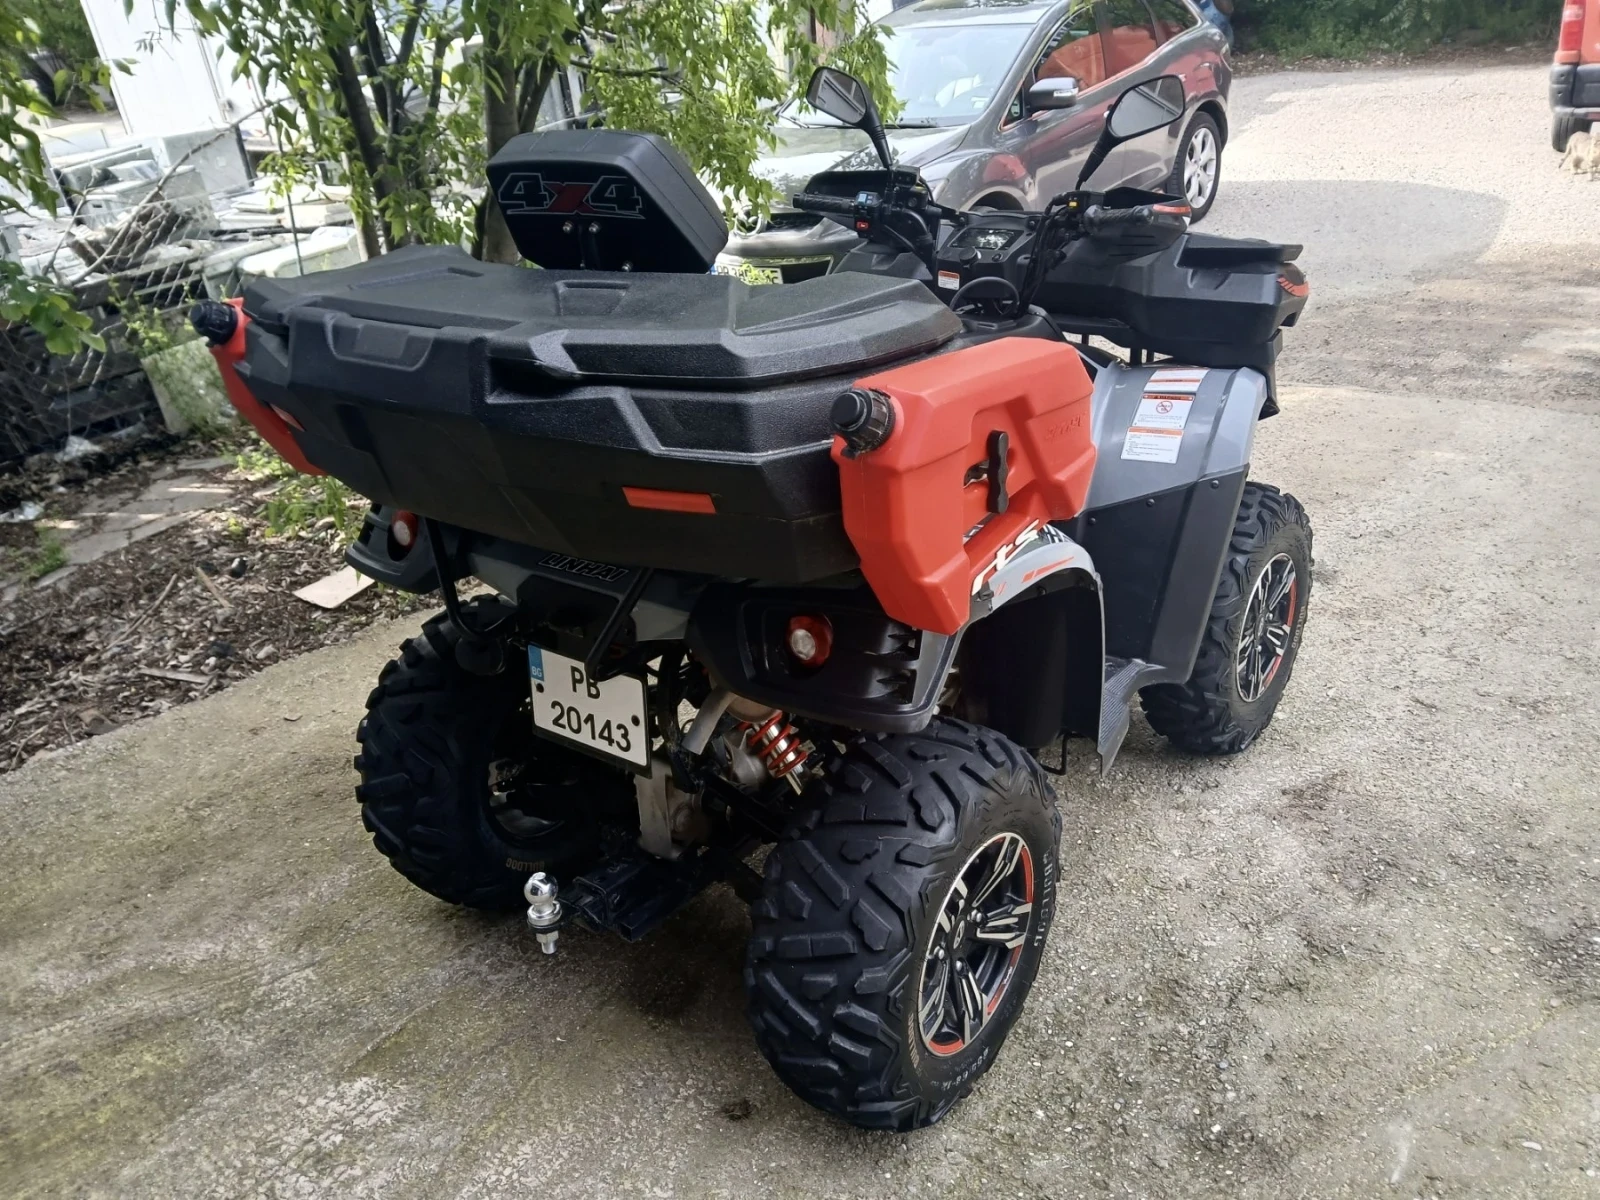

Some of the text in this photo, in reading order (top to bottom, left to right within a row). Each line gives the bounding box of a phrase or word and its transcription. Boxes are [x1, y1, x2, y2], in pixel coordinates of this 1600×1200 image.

[538, 553, 630, 582] LINHAI
[531, 666, 543, 678] BG
[570, 665, 601, 700] PB
[550, 700, 632, 753] 20143
[1033, 863, 1053, 947] BULLDOG
